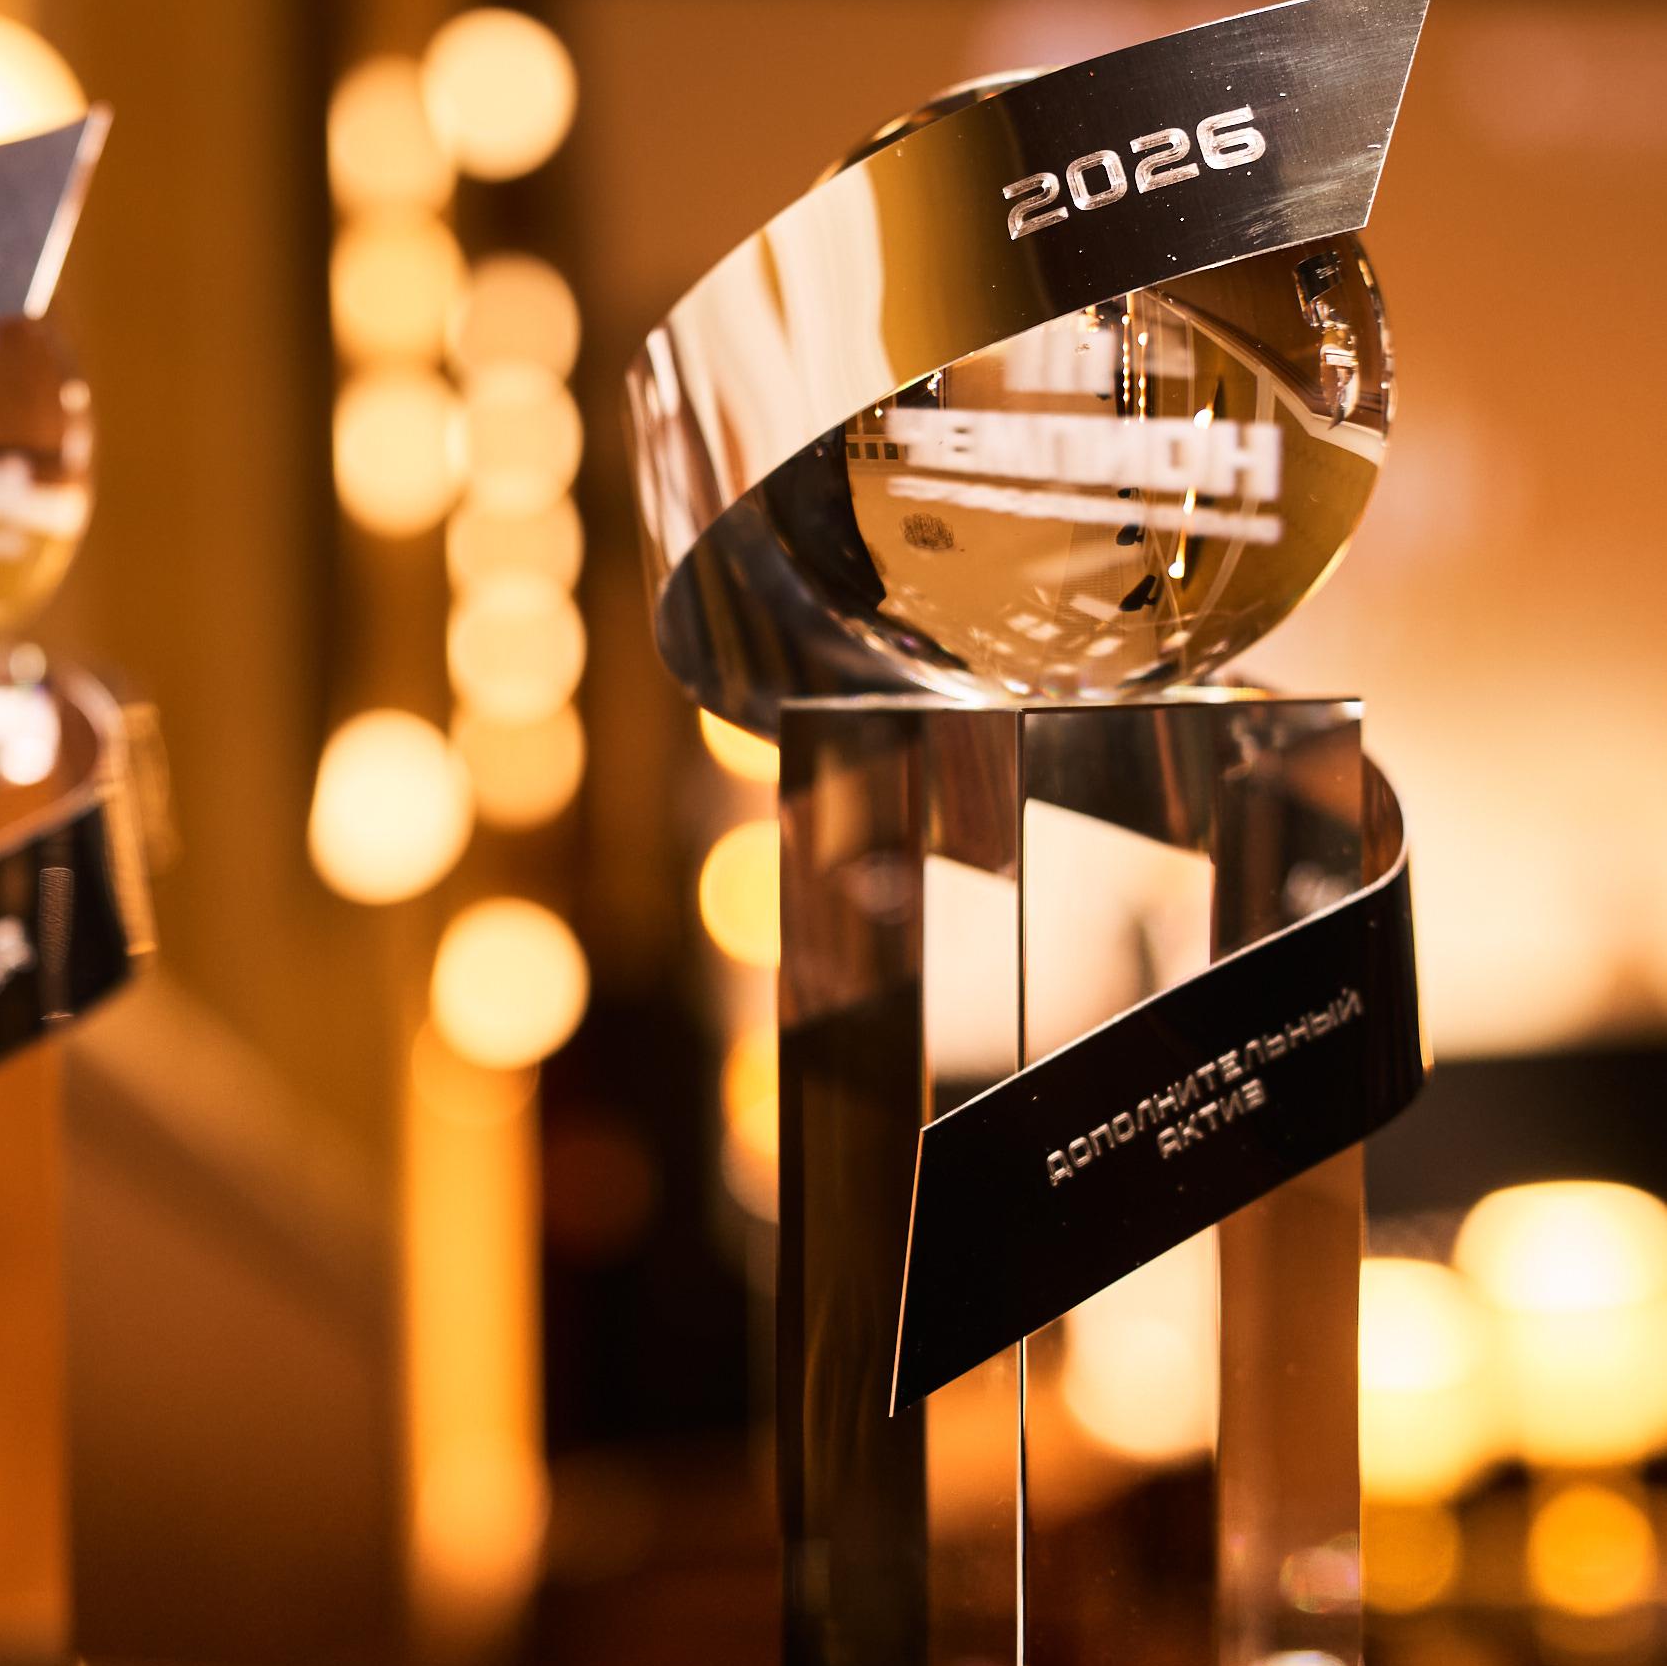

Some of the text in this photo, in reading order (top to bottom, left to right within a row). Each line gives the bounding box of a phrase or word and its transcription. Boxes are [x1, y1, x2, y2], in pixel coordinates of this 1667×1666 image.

[1002, 103, 1266, 240] 2026
[1046, 986, 1365, 1188] ДОПОЛНИТЕЛЬНЫЙ
[1156, 1077, 1267, 1160] АКТИВ
